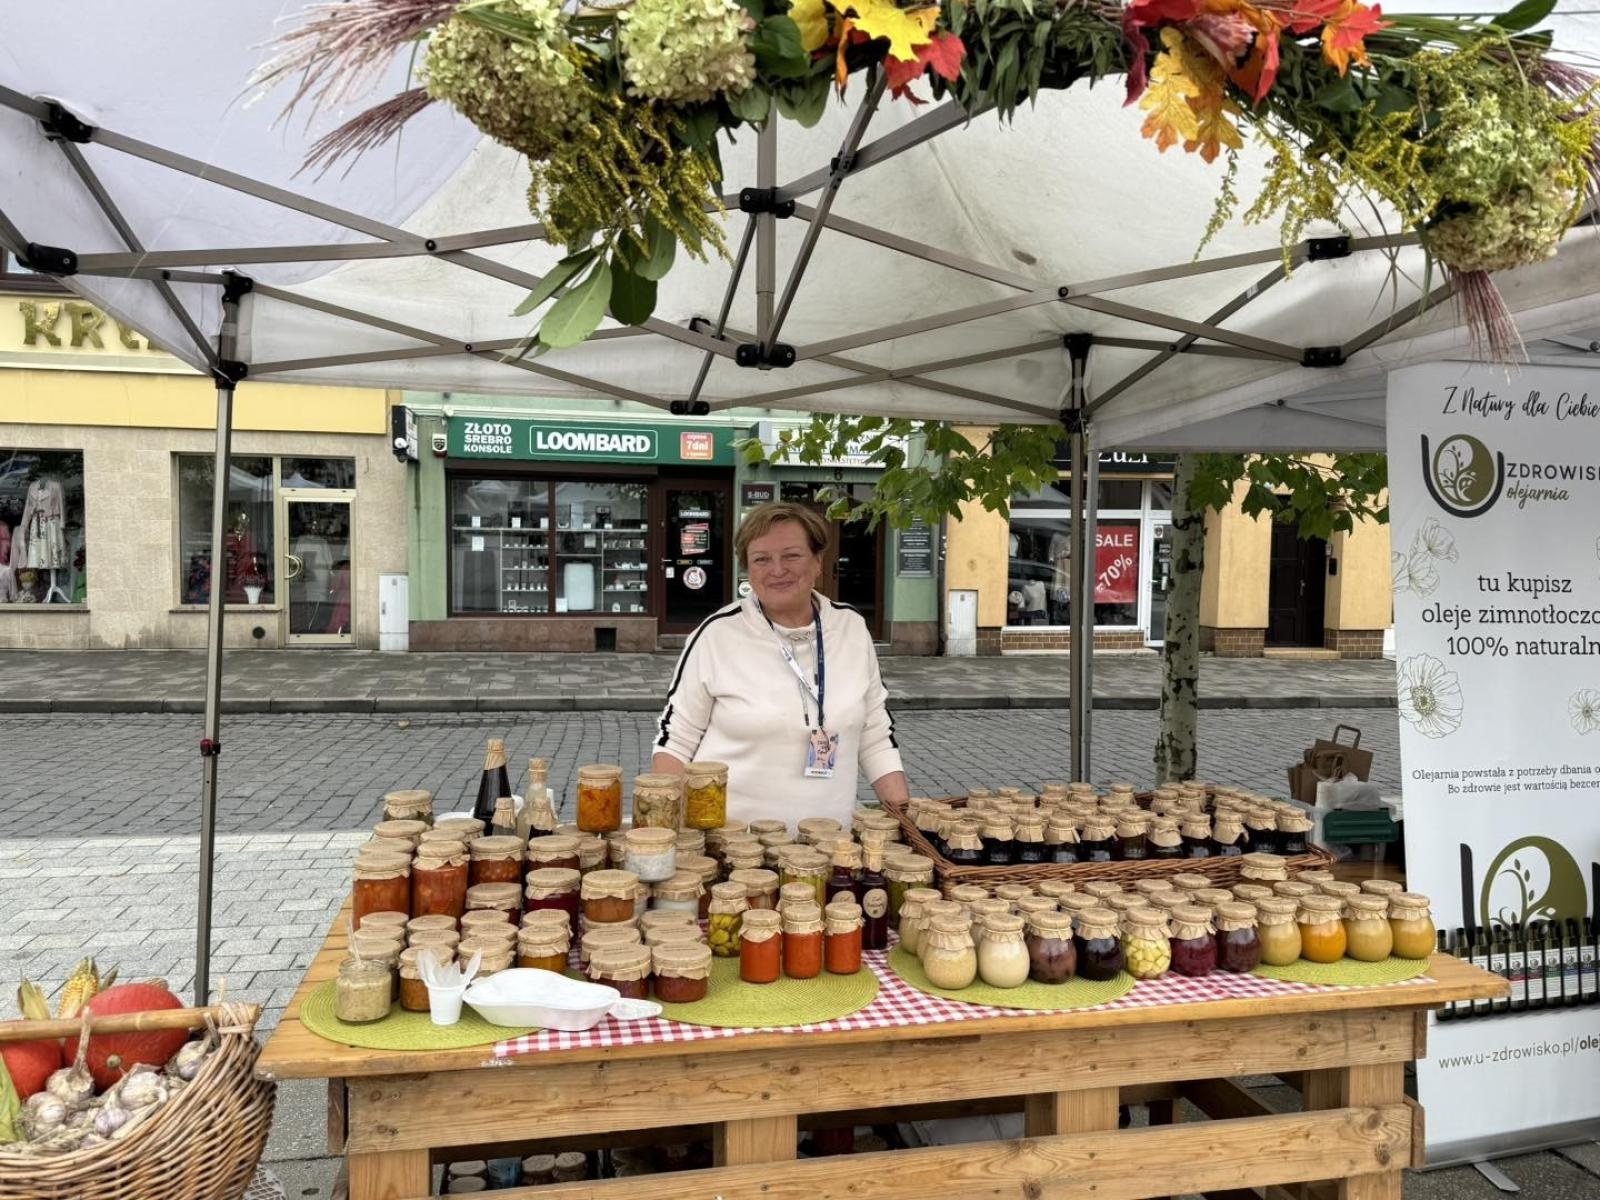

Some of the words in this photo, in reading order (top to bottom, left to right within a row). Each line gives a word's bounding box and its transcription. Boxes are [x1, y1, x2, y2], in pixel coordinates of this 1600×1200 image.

[19, 301, 162, 351] KR
[1442, 386, 1458, 414] Z
[1462, 387, 1516, 420] Natury
[1522, 390, 1549, 417] dla
[1556, 392, 1600, 420] Ciebie
[464, 422, 512, 435] ZŁOTO
[464, 434, 512, 445] SREBRO
[464, 444, 512, 454] KONSOLE
[536, 431, 651, 453] LOOMBARD
[1507, 481, 1570, 509] olejarnia
[1096, 534, 1133, 547] SALE
[1478, 575, 1500, 592] tu
[1507, 572, 1572, 599] kupisz
[1422, 603, 1471, 629] oleje
[1448, 637, 1509, 656] 100%
[1412, 769, 1460, 782] Olejarnia
[1462, 767, 1506, 781] powstała
[1517, 766, 1557, 779] potrzeby
[1560, 764, 1592, 775] dbania
[1448, 784, 1460, 794] Bo
[1462, 782, 1501, 793] zdrowie
[1504, 782, 1520, 794] jest
[1524, 780, 1567, 791] wartością
[1439, 1034, 1600, 1069] www.u-zdrowisko.pl/ole
